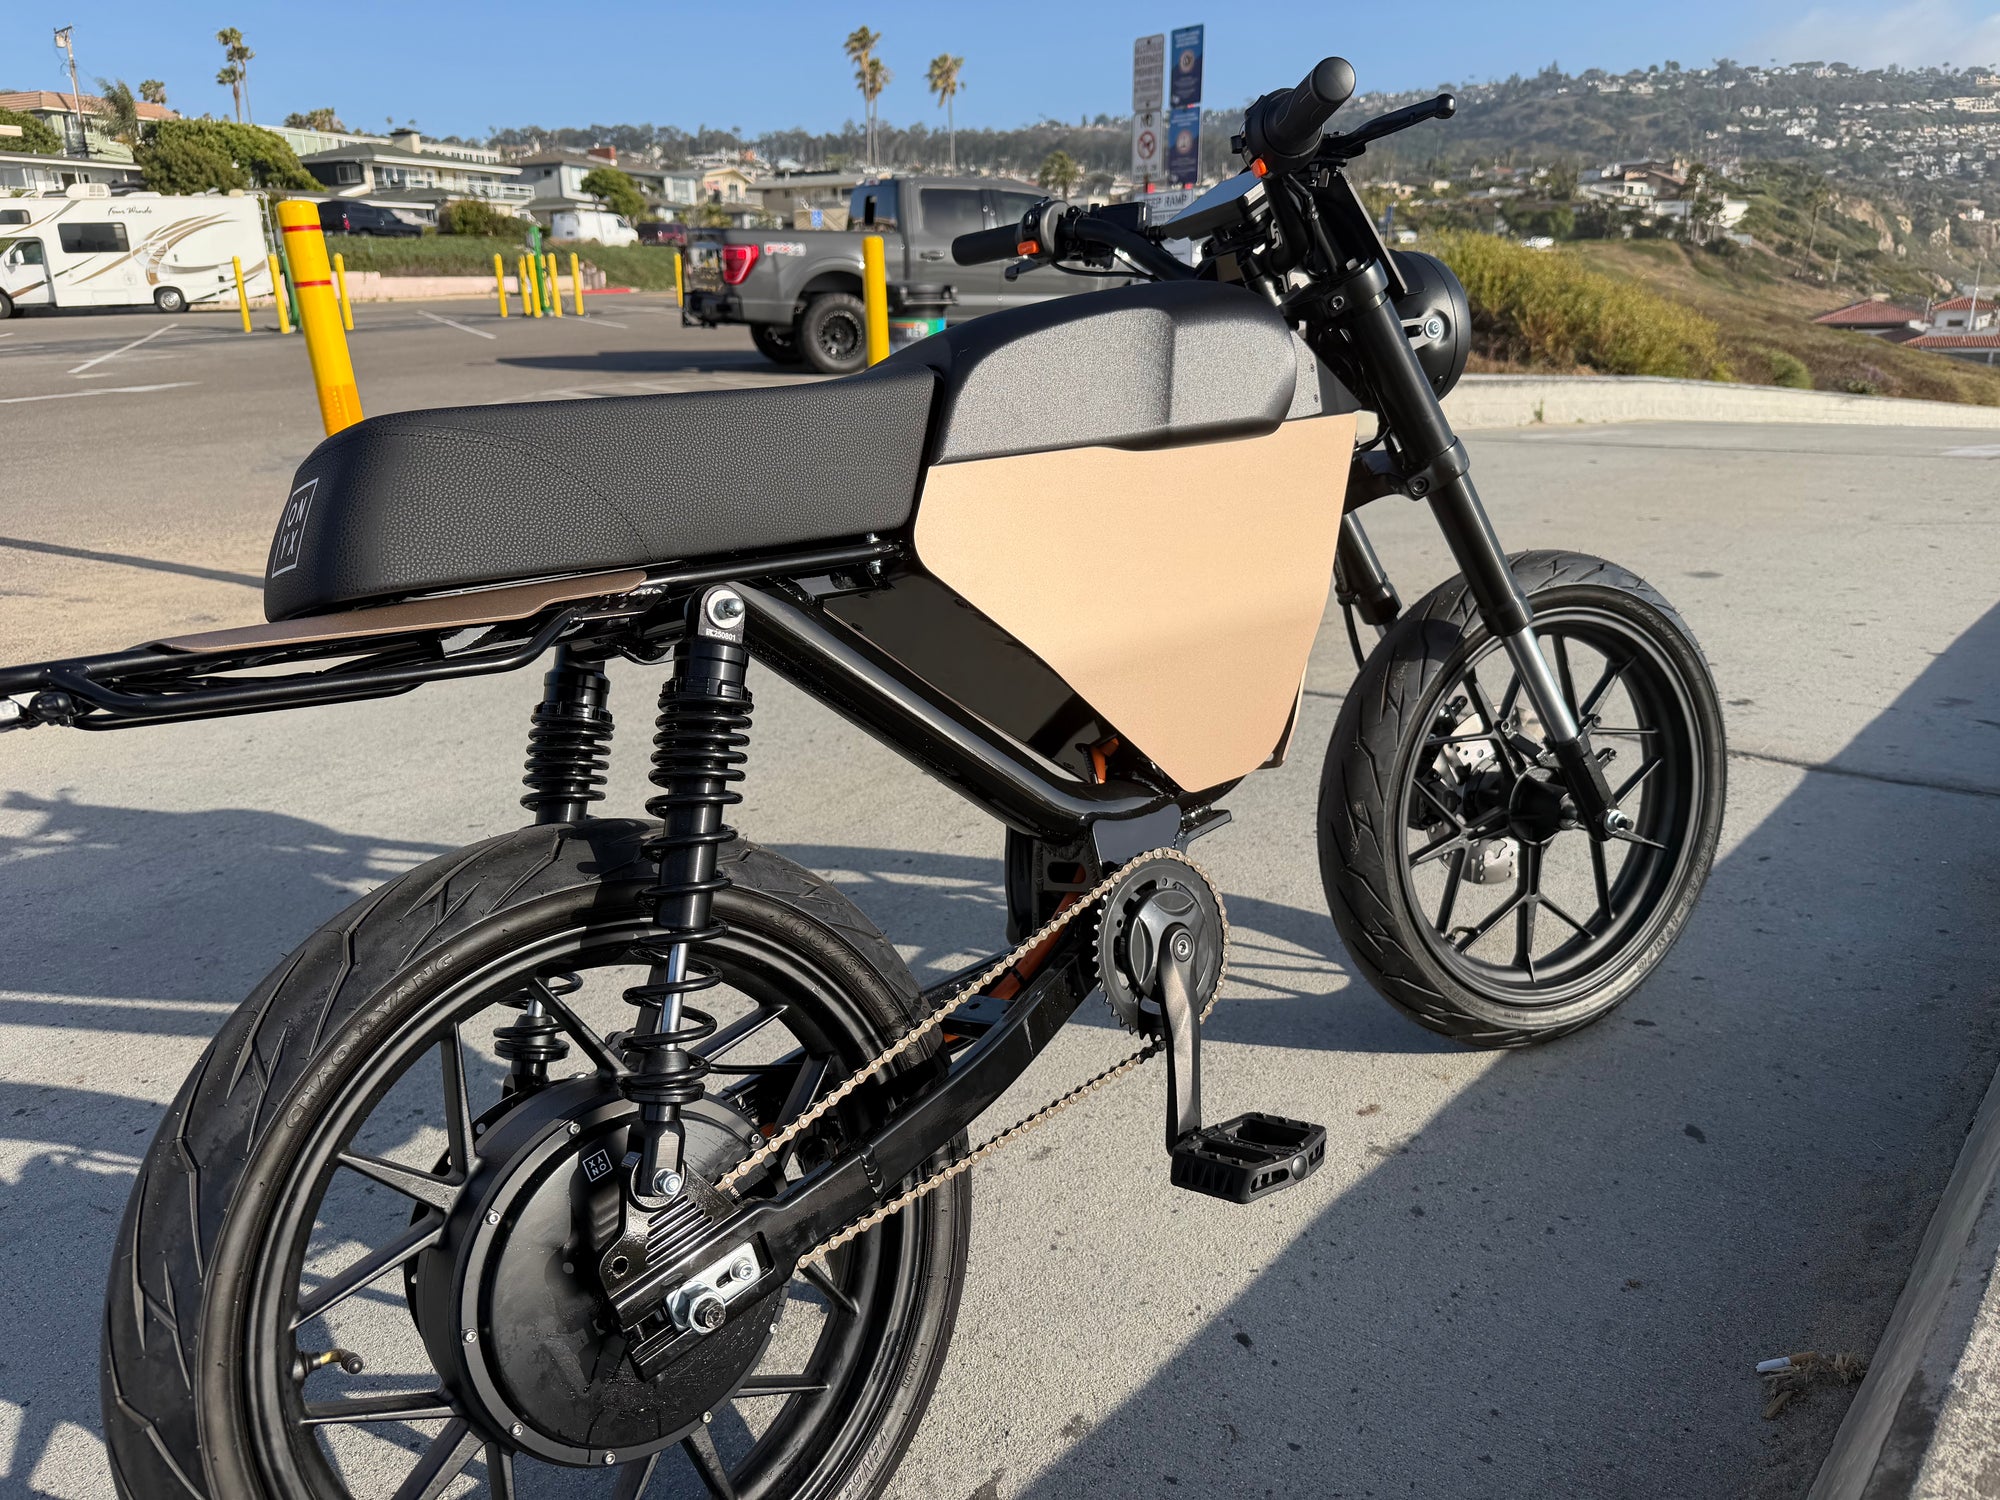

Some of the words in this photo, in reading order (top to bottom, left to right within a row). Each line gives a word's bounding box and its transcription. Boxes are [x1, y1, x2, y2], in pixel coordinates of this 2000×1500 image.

[1164, 193, 1187, 208] RAMP
[287, 496, 308, 528] ON
[280, 528, 299, 560] YX
[588, 1155, 604, 1169] YX
[591, 1163, 607, 1176] ON
[836, 1427, 890, 1500] VENGE
